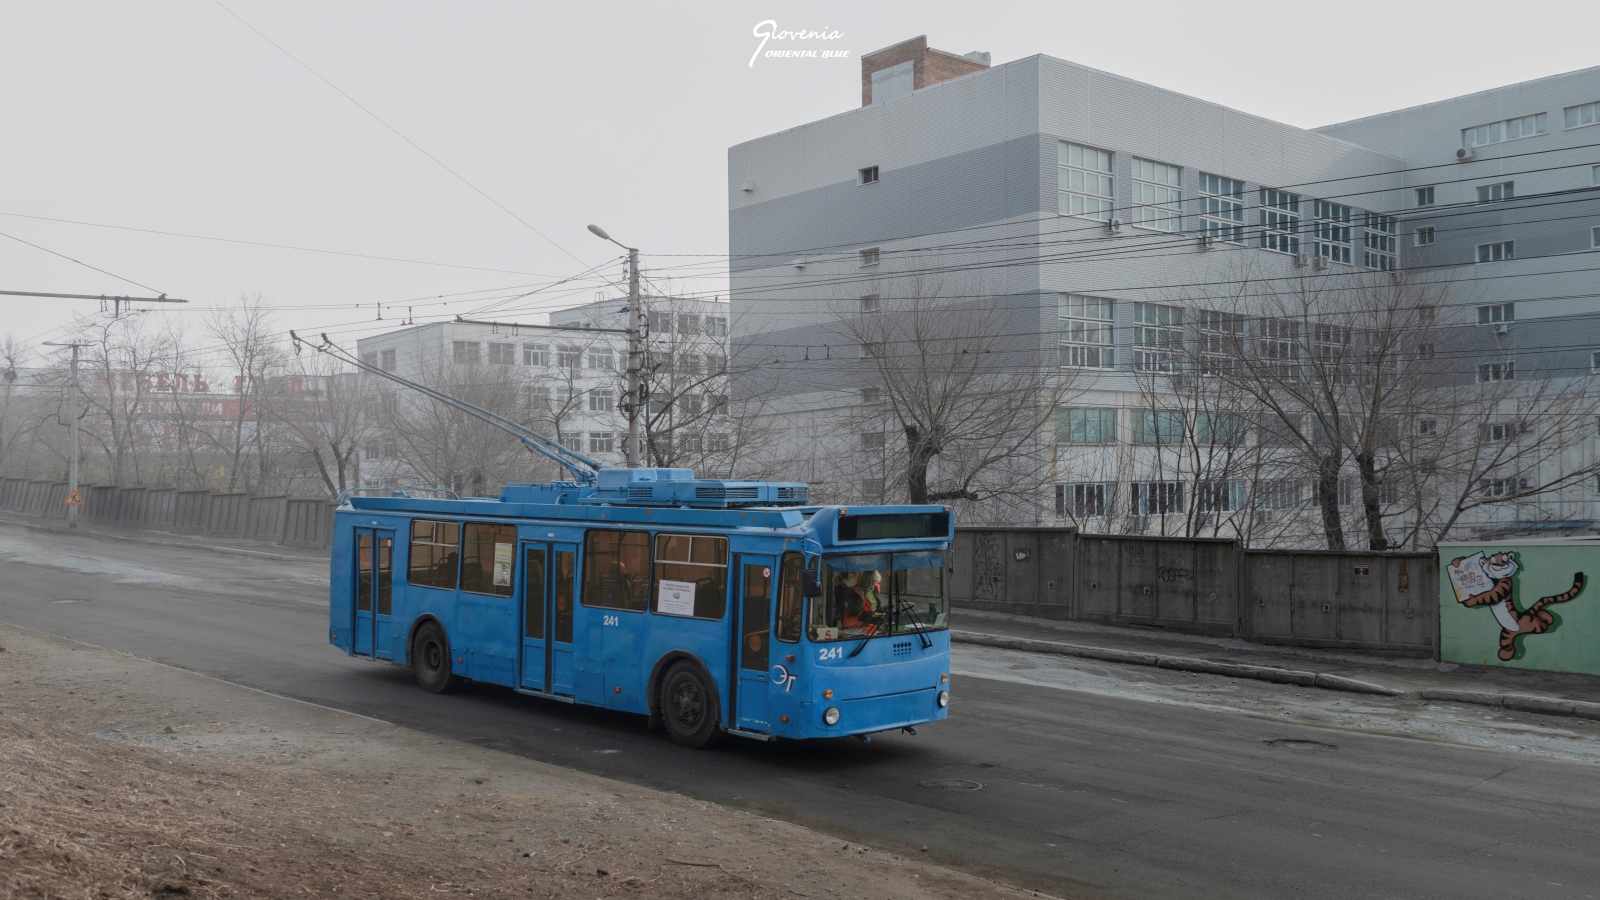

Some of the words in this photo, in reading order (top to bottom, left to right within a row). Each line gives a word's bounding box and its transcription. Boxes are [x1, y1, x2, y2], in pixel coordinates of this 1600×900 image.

[603, 614, 619, 627] 241
[824, 630, 832, 640] 5
[819, 646, 843, 660] 241
